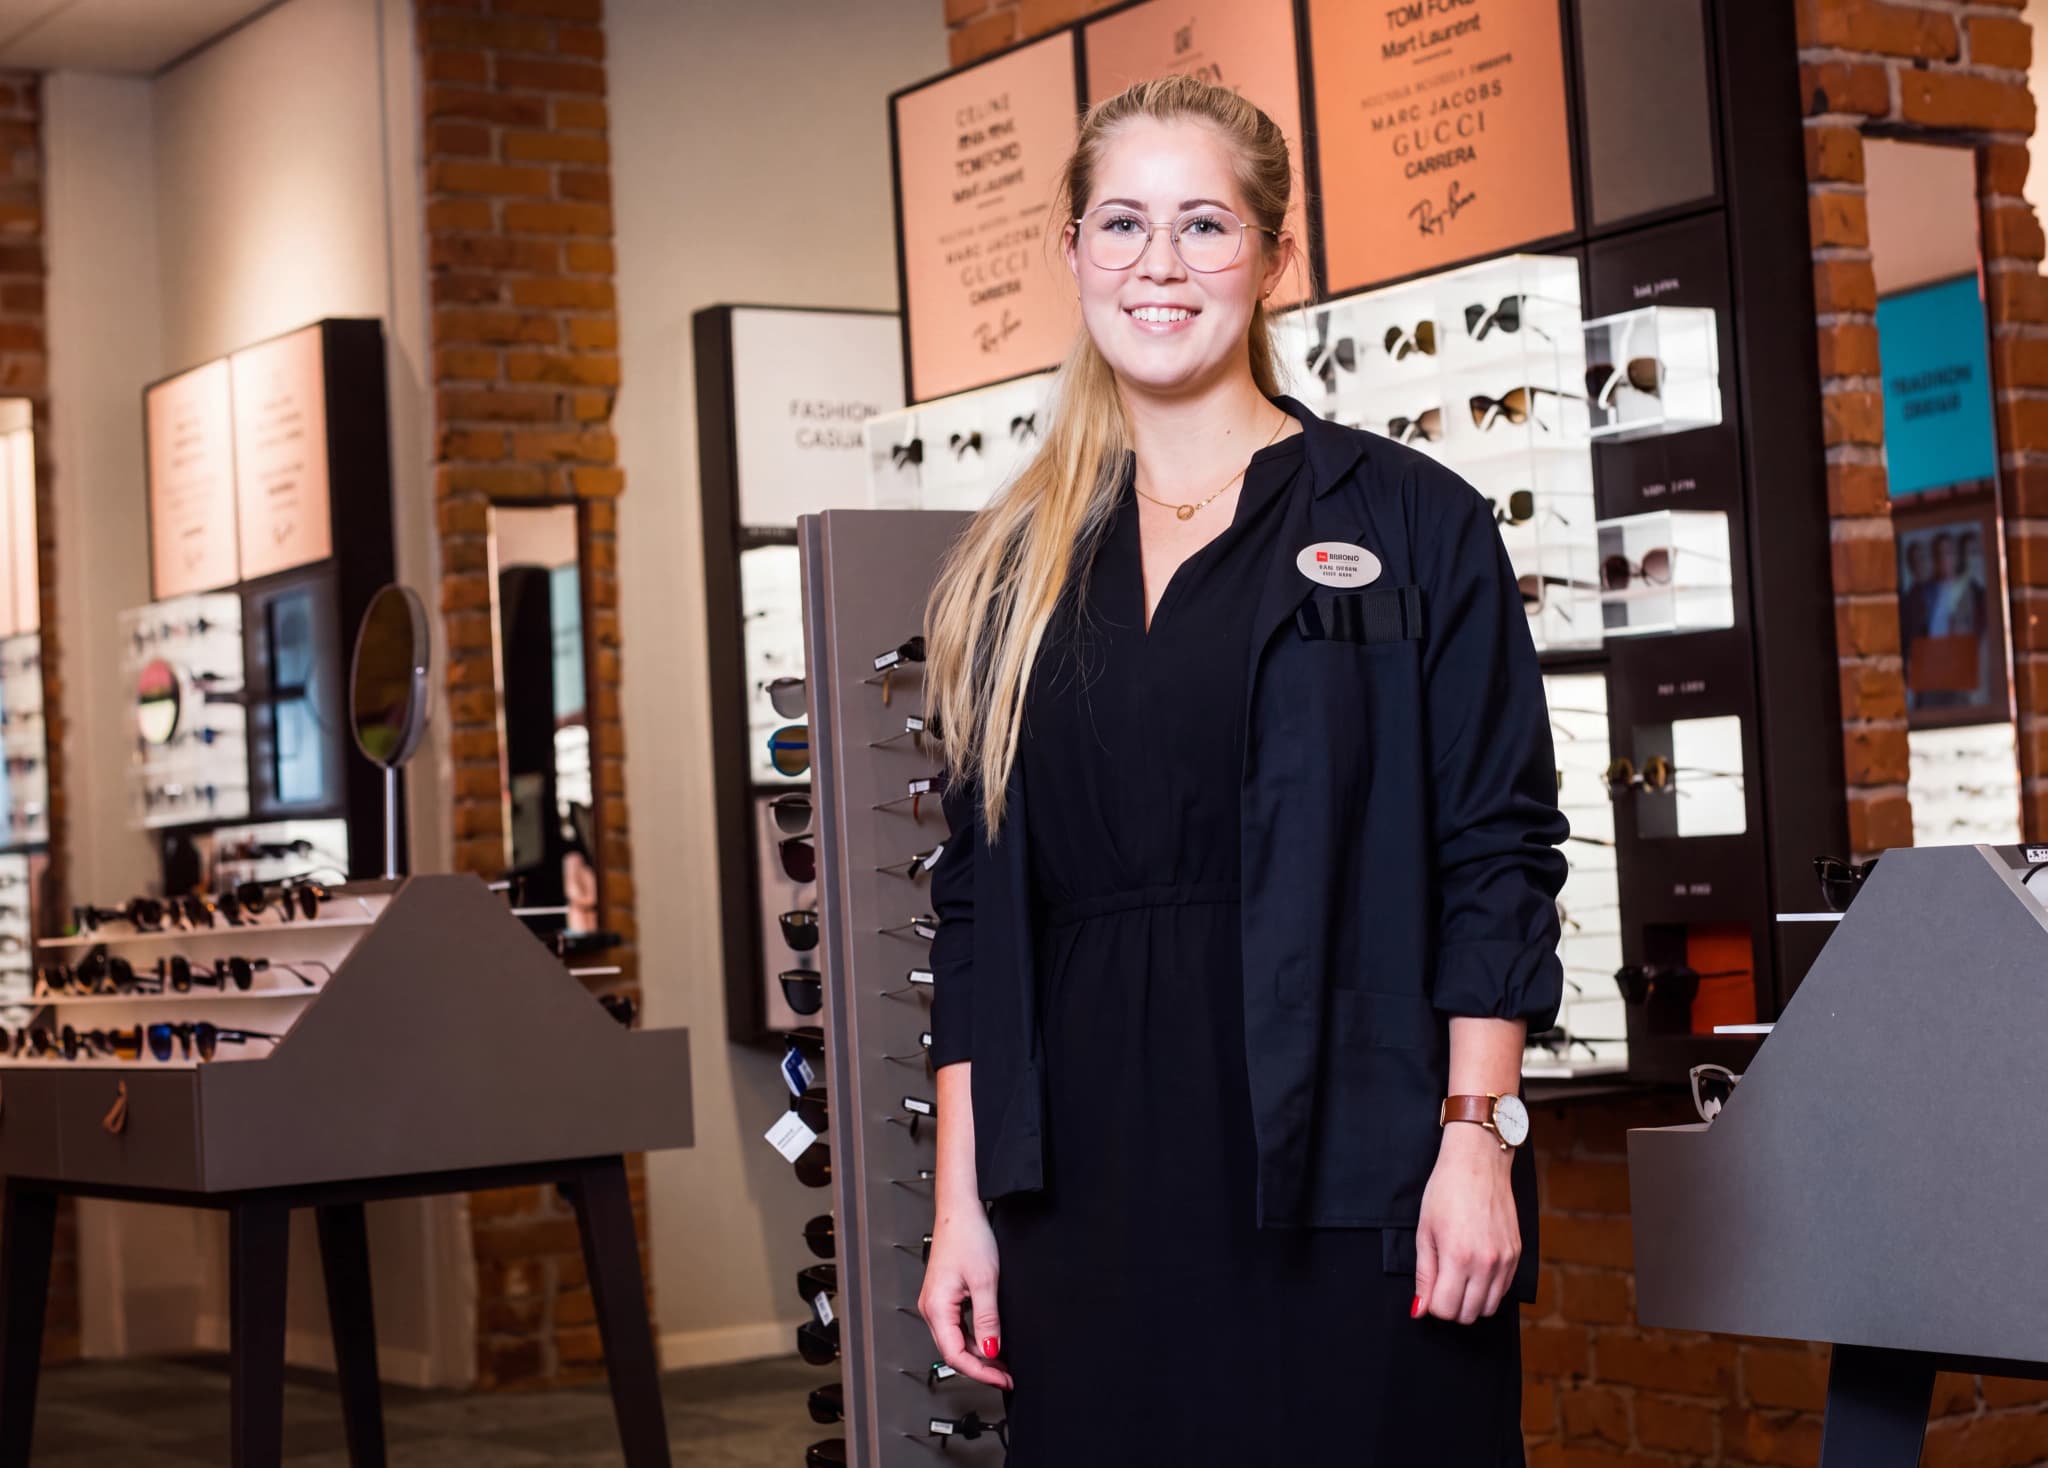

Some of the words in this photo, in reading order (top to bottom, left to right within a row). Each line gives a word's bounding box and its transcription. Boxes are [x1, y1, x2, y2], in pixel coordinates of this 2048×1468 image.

[1386, 2, 1422, 30] TOM
[1427, 0, 1475, 16] FO
[1371, 104, 1420, 131] MARC
[1431, 79, 1502, 116] JACOBS
[1393, 111, 1485, 157] GUCCI
[1405, 145, 1477, 179] CARRERA
[794, 427, 864, 449] CASUA
